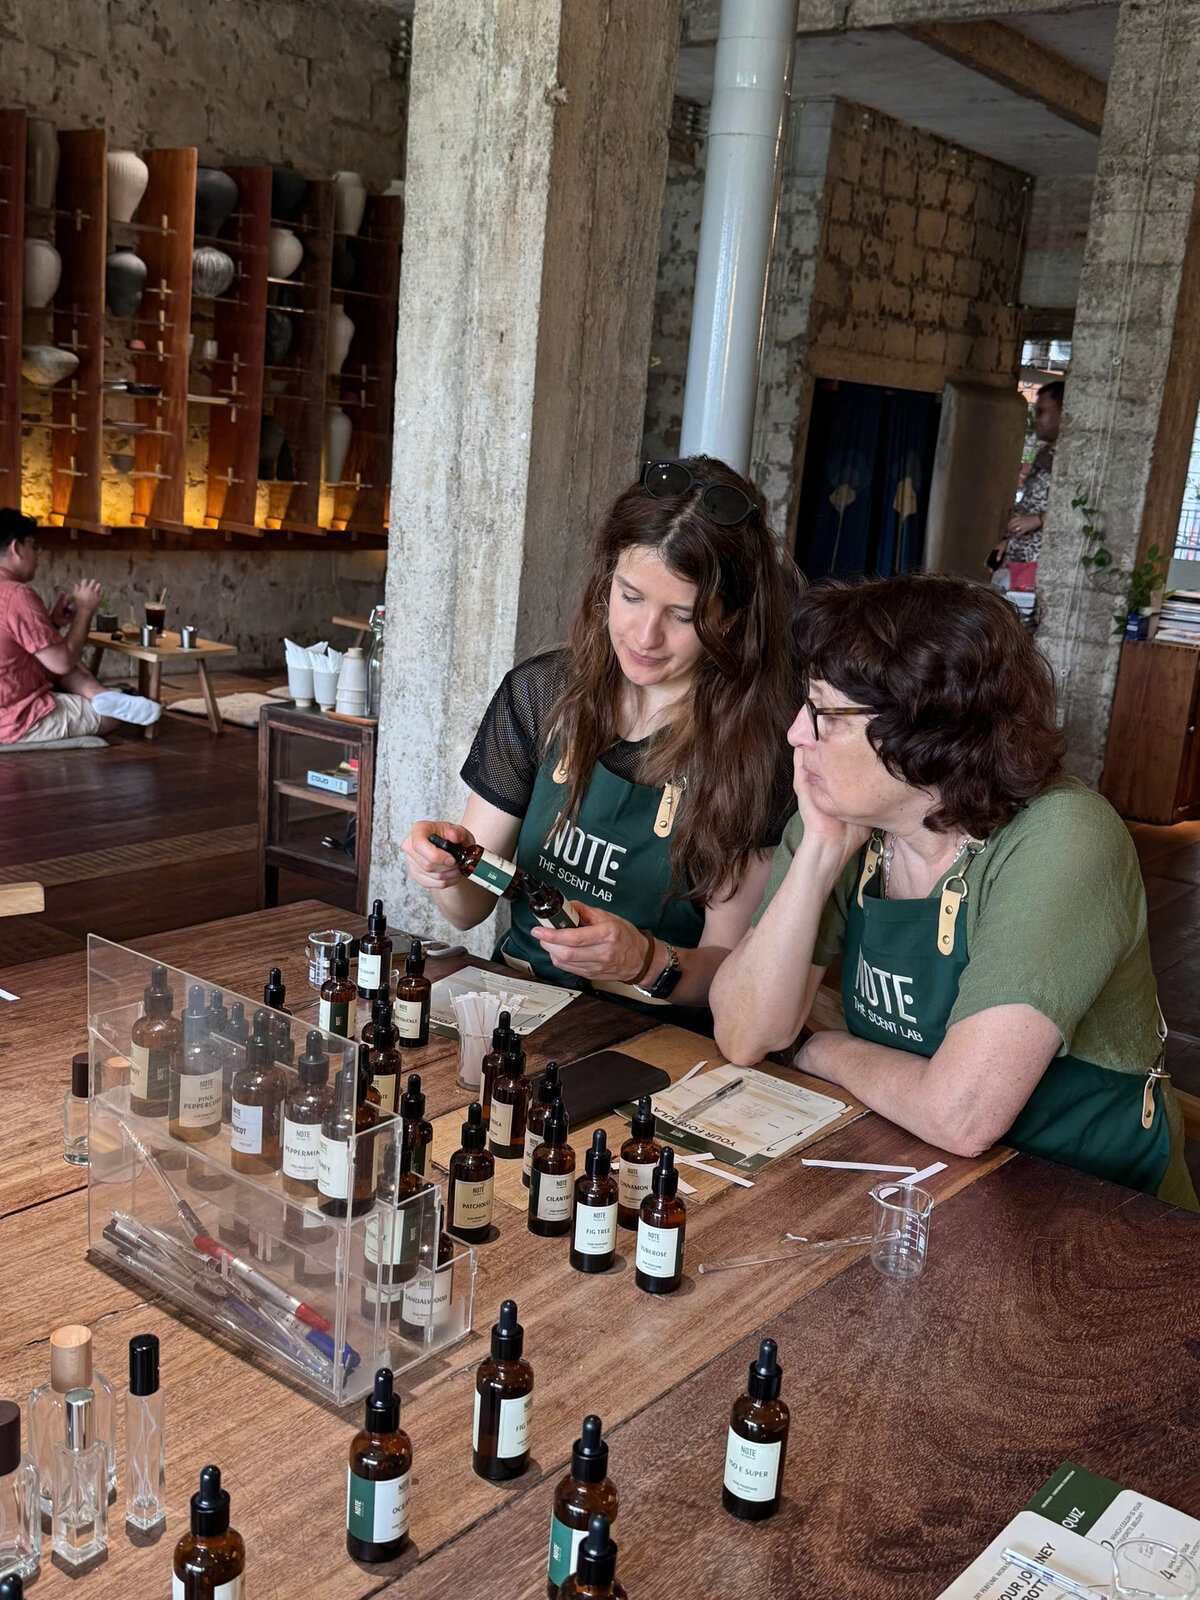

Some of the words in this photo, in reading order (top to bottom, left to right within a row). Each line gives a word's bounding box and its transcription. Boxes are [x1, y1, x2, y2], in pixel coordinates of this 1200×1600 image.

[543, 811, 627, 886] NOTE
[538, 855, 556, 874] THE
[557, 868, 590, 892] SCENT
[591, 885, 613, 902] LAB
[855, 944, 917, 1024] NOTE
[853, 995, 866, 1017] THE
[868, 1009, 897, 1034] SCENT
[900, 1026, 923, 1042] LAB
[295, 1129, 312, 1139] NOTE
[704, 1132, 736, 1147] YOUR
[285, 1145, 321, 1157] PEPPERMIN
[627, 1168, 639, 1176] NOTE
[555, 1180, 568, 1188] NOTE
[472, 1186, 485, 1195] NOTE
[592, 1211, 606, 1219] NOTE
[597, 1227, 610, 1235] TREE
[647, 1231, 661, 1240] NOTE
[640, 1244, 668, 1258] TUBEROSE
[740, 1445, 757, 1457] NOTE
[744, 1468, 769, 1478] SUPER
[354, 1498, 362, 1517] NOTE
[1061, 1506, 1086, 1529] QUIZ
[552, 1542, 560, 1561] NOTE
[1160, 1569, 1177, 1580] 4
[1021, 1578, 1049, 1600] BOTT
